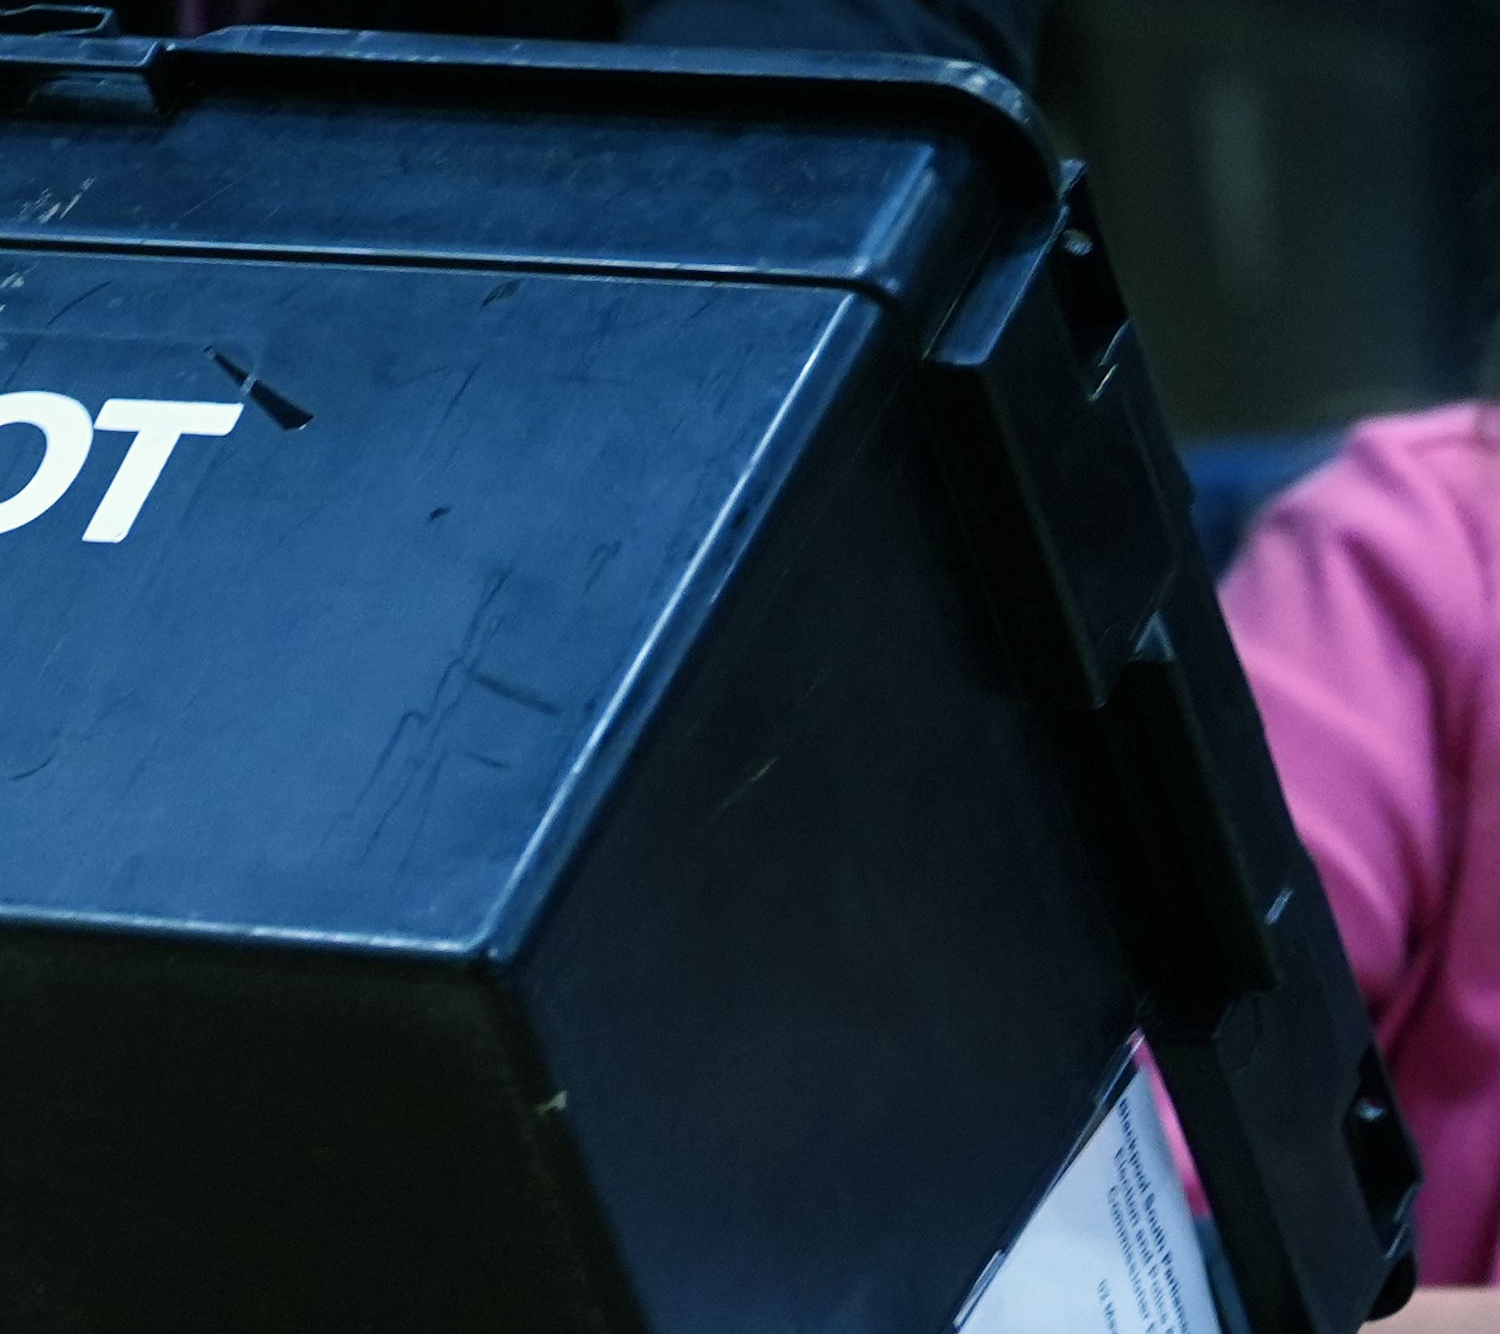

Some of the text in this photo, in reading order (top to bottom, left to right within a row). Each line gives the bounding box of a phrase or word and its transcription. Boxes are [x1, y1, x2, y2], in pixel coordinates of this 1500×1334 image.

[1107, 1185, 1150, 1320] Commissioner
[1114, 1147, 1140, 1227] Election
[1135, 1229, 1154, 1266] and
[1147, 1264, 1168, 1325] Police
[1119, 1098, 1150, 1194] Blackpool
[1143, 1193, 1165, 1253] South
